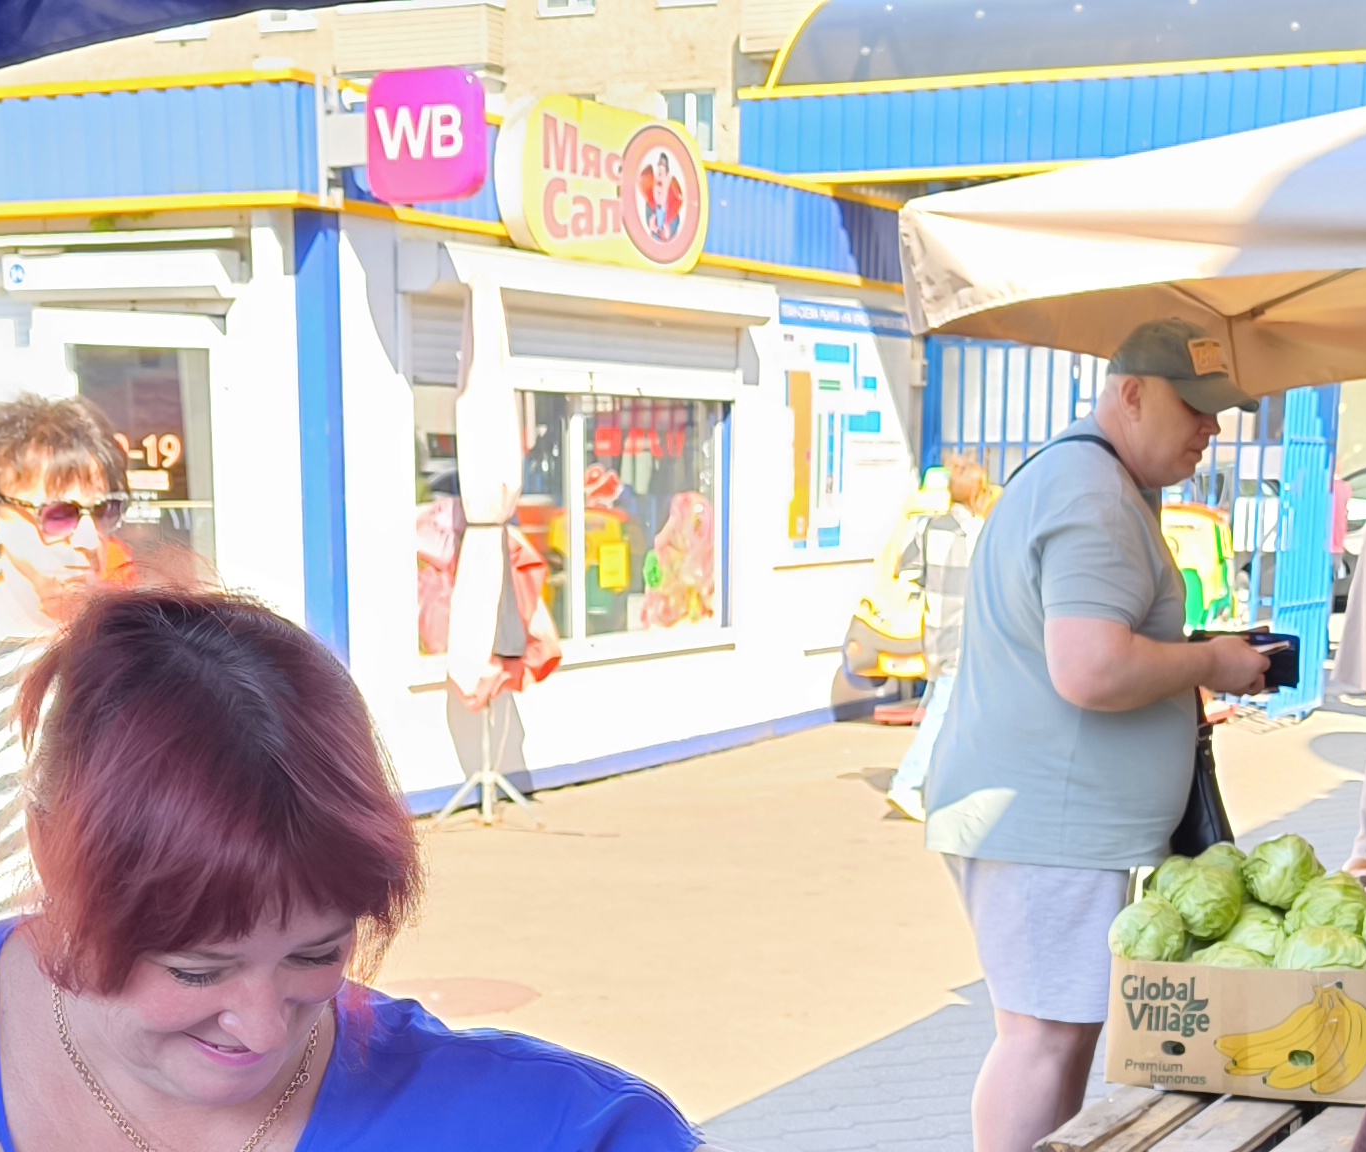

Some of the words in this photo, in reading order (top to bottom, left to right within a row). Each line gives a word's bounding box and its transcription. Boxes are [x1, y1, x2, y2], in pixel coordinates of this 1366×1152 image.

[375, 105, 463, 161] WB
[544, 177, 623, 240] Сал
[1121, 975, 1209, 1001] Global
[1125, 1003, 1210, 1037] Village
[1125, 1059, 1182, 1072] Premium
[1150, 1072, 1206, 1085] bananas
